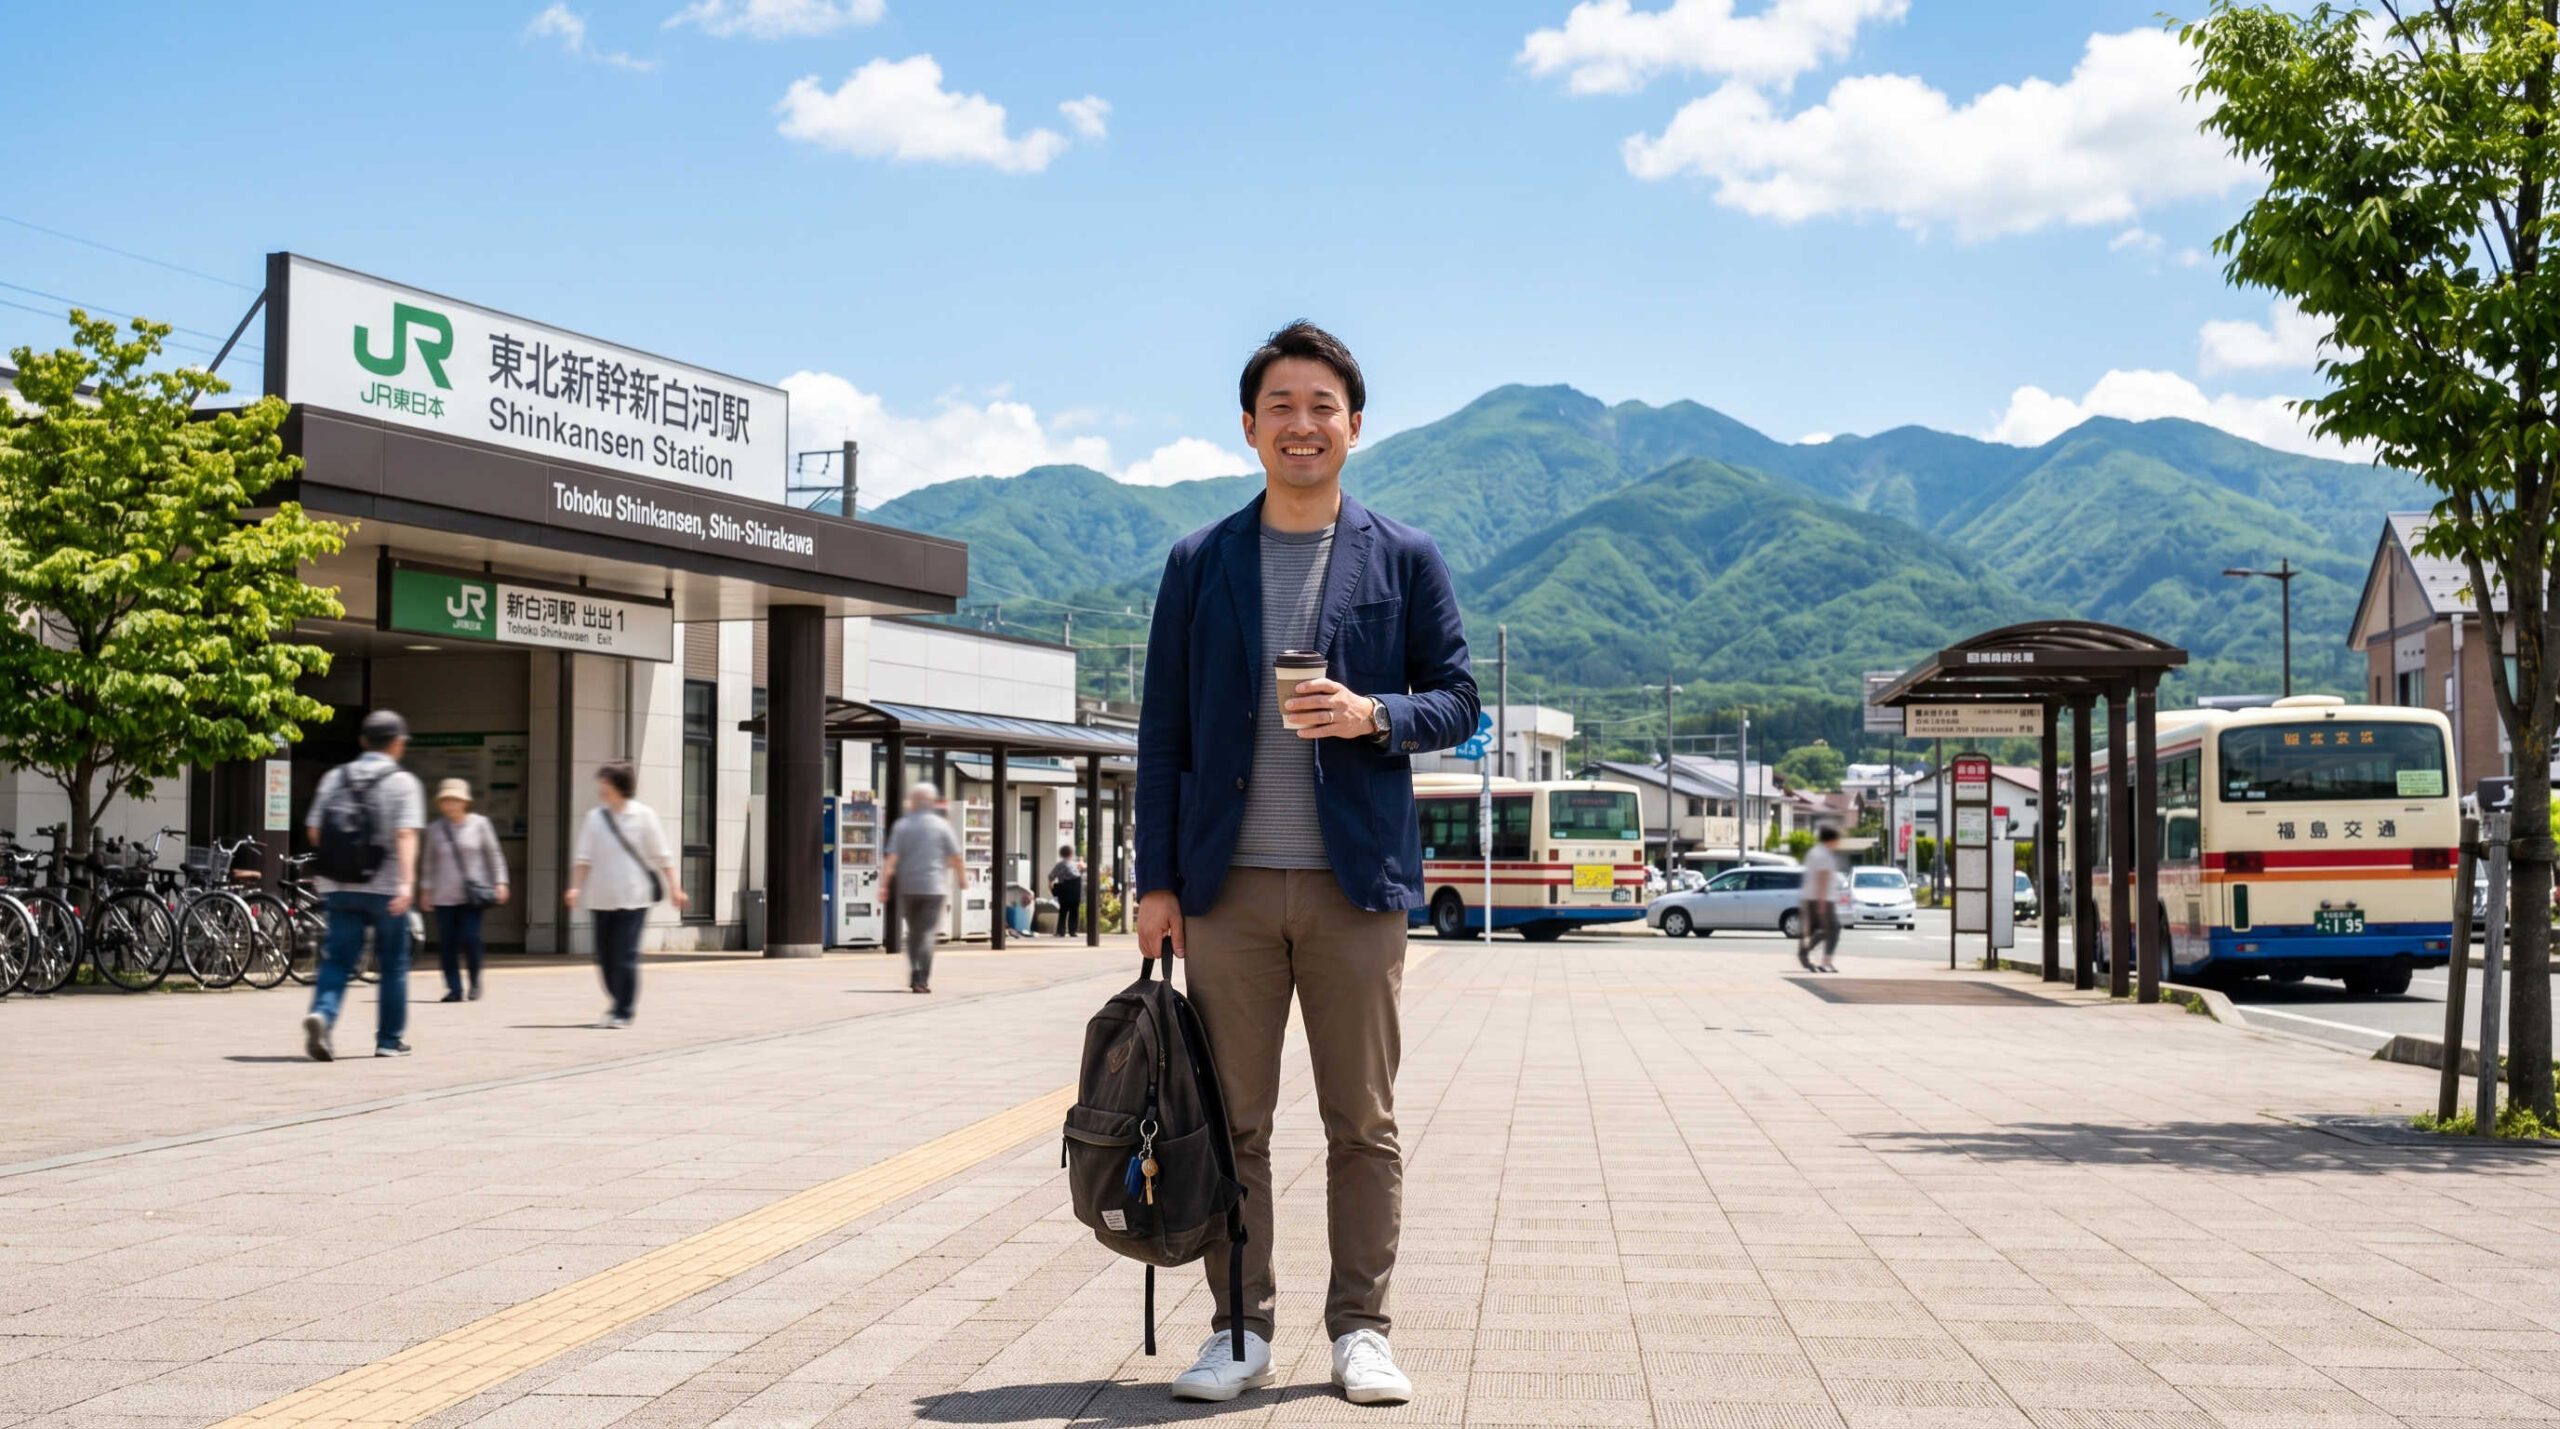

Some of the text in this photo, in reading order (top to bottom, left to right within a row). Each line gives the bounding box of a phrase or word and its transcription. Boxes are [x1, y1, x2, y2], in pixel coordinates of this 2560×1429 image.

[354, 302, 454, 391] JR
[361, 382, 445, 419] JR東日本
[489, 333, 750, 445] 東北新幹新白河駅
[489, 397, 733, 481] Shinkansen Station
[553, 482, 814, 556] Tohoku Shinkansen, Shin-Shirakawa
[447, 585, 486, 620] JR
[2277, 820, 2396, 840] 福島交通
